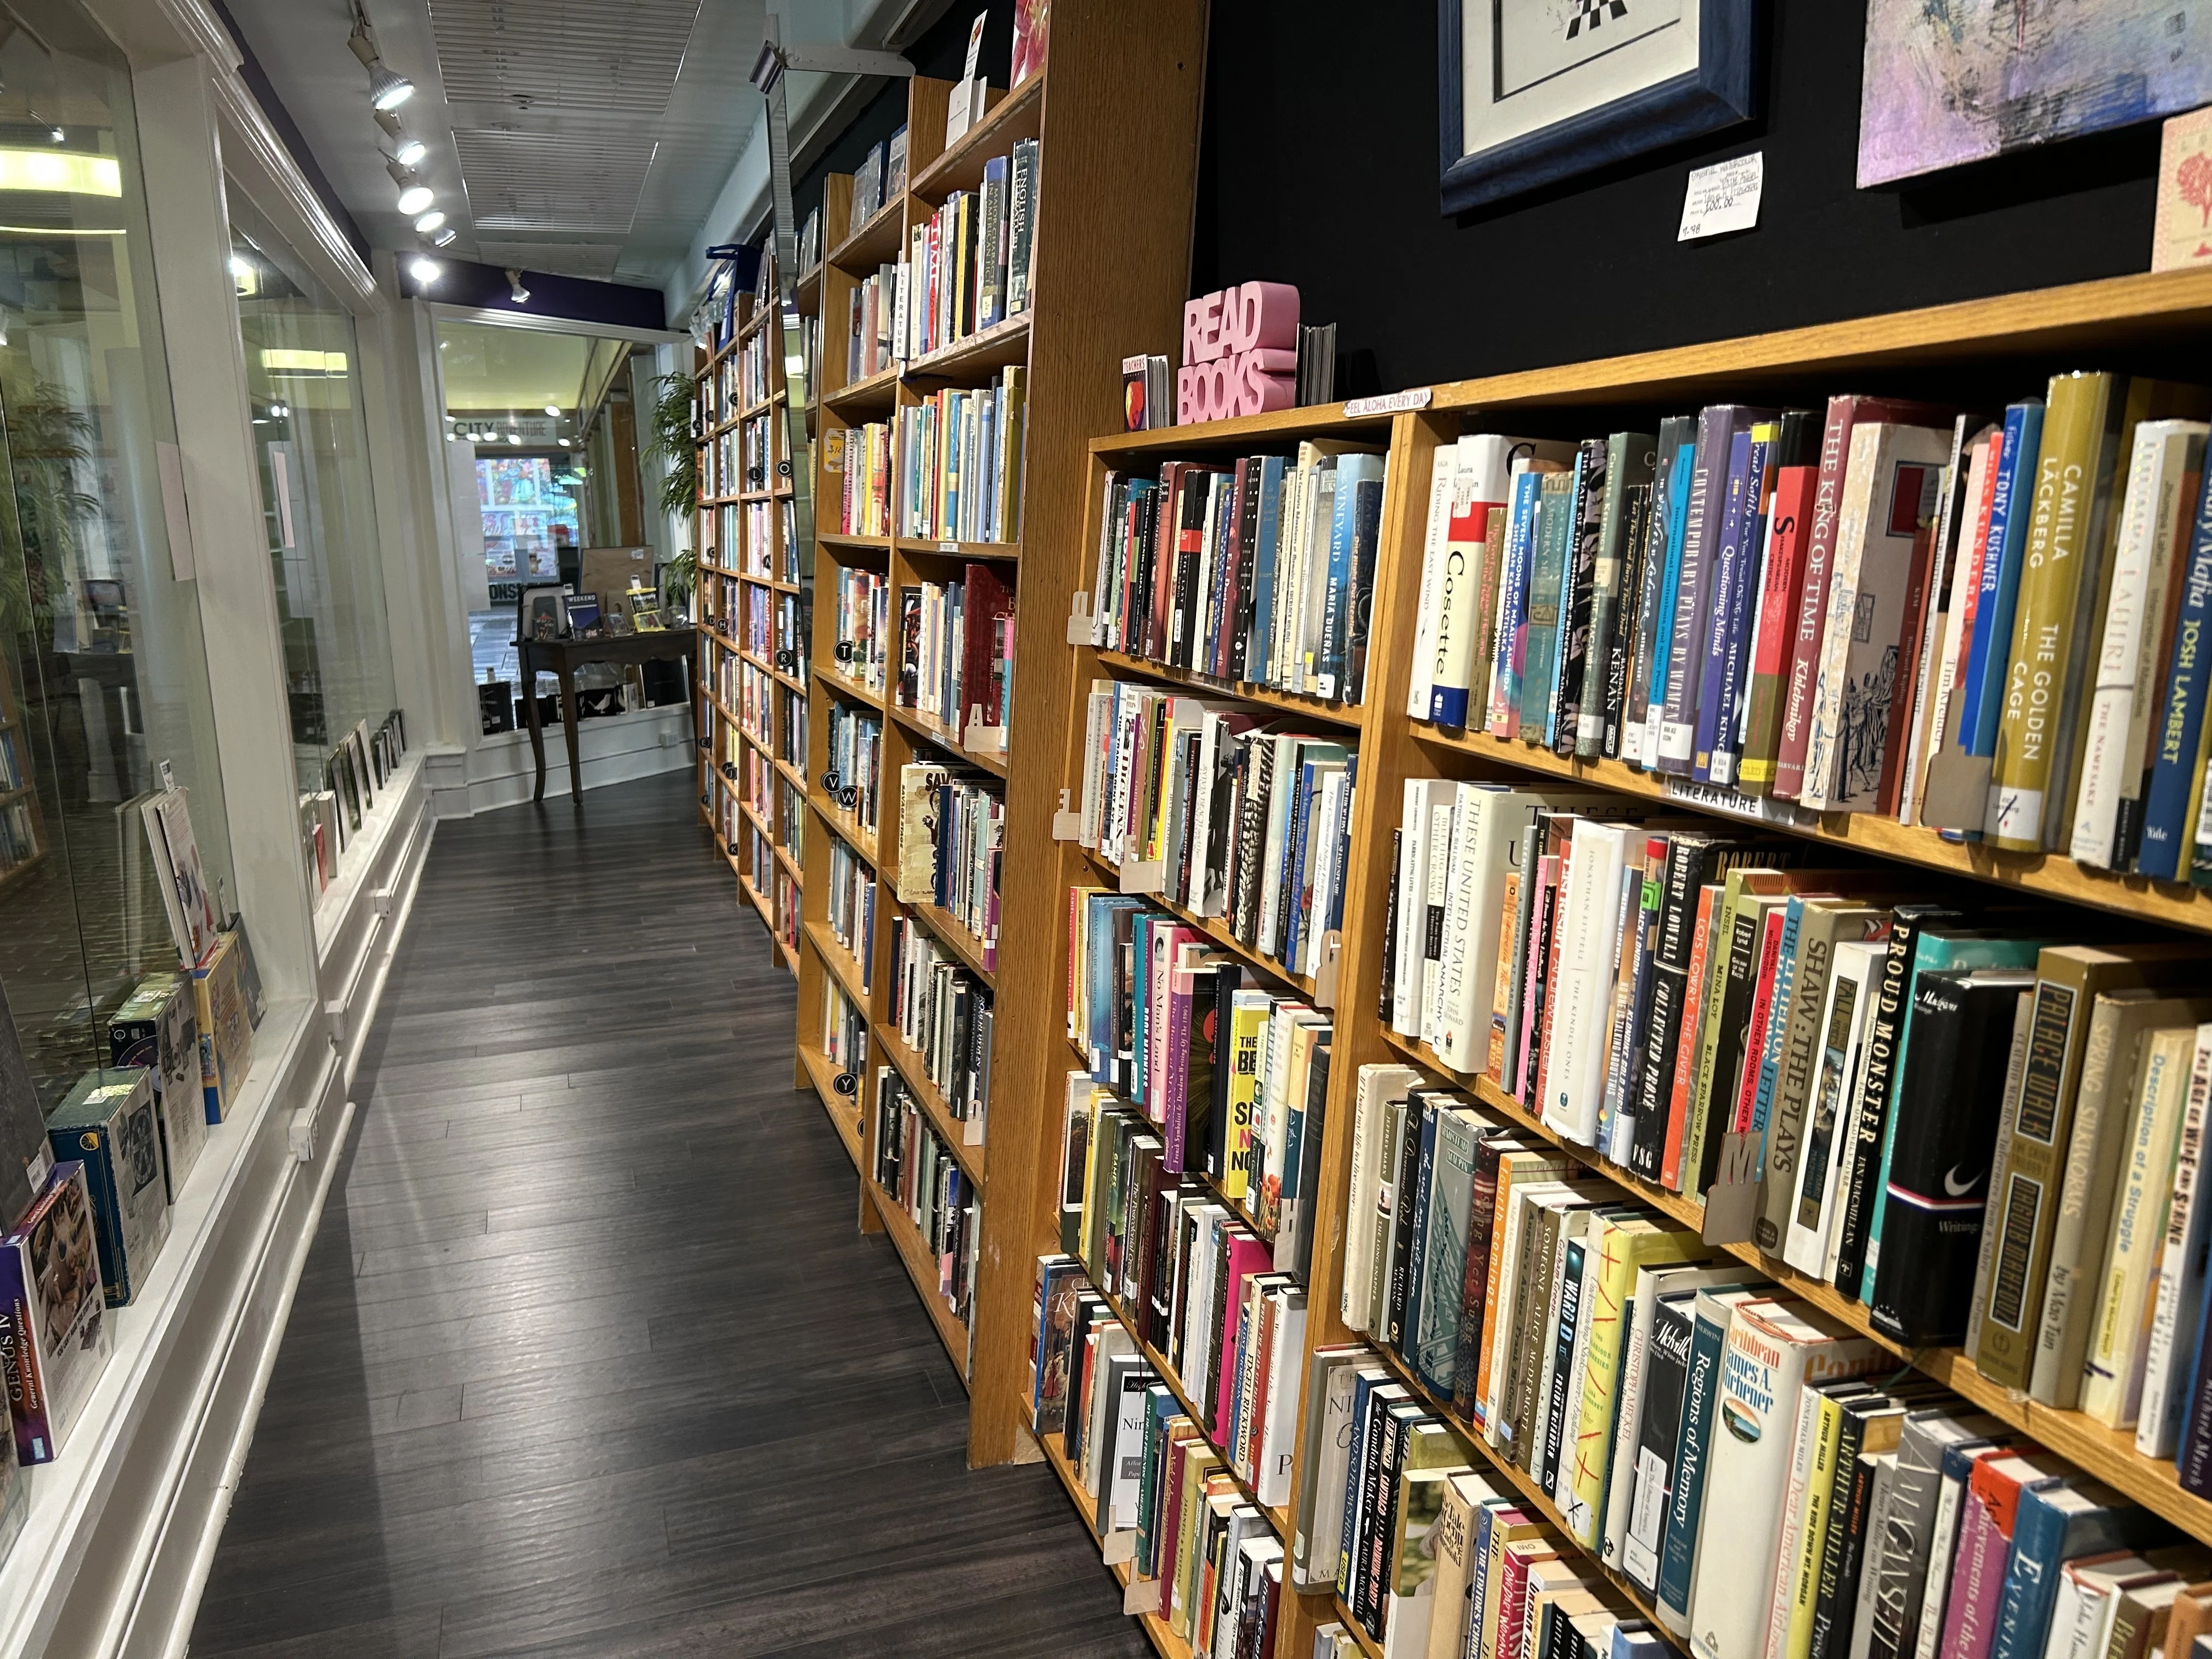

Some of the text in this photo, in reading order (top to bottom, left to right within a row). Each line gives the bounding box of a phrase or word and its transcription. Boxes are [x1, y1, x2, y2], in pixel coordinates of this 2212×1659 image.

[1018, 167, 1028, 233] ENGLISH
[1183, 281, 1262, 366] READ
[1123, 355, 1145, 374] TEACHERS
[1178, 349, 1264, 426] BOOKS
[454, 421, 494, 437] CITY
[1346, 391, 1429, 414] FEEL ALOHA EVERY DAY
[1457, 464, 1473, 474] Laura
[1579, 479, 1588, 508] TALE
[1606, 453, 1617, 495] CHARLES
[1745, 476, 1759, 517] Softly
[1330, 484, 1348, 562] VINEYARD
[1520, 507, 1529, 543] SEVEN
[1682, 469, 1709, 589] CONTEMPORARY
[1800, 419, 1844, 642] THE TIME
[1980, 469, 2011, 594] TONY KUSHNER
[2029, 457, 2058, 569] LÄCKBERG
[2051, 464, 2082, 561] CAMILLA
[1501, 523, 1519, 652] SHEHAN KARUNATILAKA
[1514, 545, 1524, 588] MOONS
[1964, 505, 1986, 611] KUNDERA
[1435, 550, 1464, 675] Cosette
[1509, 607, 1517, 637] MAALI
[1675, 591, 1692, 640] PLAYS
[1711, 545, 1735, 657] Questioning Minds
[2103, 567, 2136, 674] LAHIRI
[781, 653, 787, 663] R
[840, 645, 849, 657] T
[1502, 639, 1512, 692] ALMEIDA
[1585, 610, 1599, 672] MACABRE
[1606, 647, 1621, 712] KENAN
[1665, 665, 1685, 720] WOMEN
[1717, 642, 1737, 752] MICHAEL KING
[1790, 658, 1810, 743] Khlebnikov
[2007, 661, 2028, 720] CAGE
[2022, 624, 2058, 762] THE GOLDEN
[2160, 618, 2201, 765] JOSH LAMBERT
[828, 777, 839, 789] V
[840, 791, 856, 803] W
[1112, 737, 1120, 803] TRANSPARENT
[1117, 755, 1130, 838] DICKENS
[1671, 782, 1757, 812] LITERATURE
[2086, 735, 2106, 808] NAMESAKE
[1464, 799, 1481, 856] THESE
[2146, 825, 2168, 842] Yale
[1454, 860, 1474, 932] UNITED
[1576, 849, 1595, 962] JONATHAN LITTELL
[1662, 844, 1690, 961] ROBERT LOWELL
[1436, 892, 1453, 1024] INTELLECTUAL ANARCHY
[1448, 935, 1467, 998] STATES
[1783, 916, 1799, 954] THE
[1547, 958, 1559, 1013] Andrew
[1676, 917, 1707, 1086] LOIS LOWRY THE GIVER
[1154, 969, 1165, 1074] No Man's Land
[1239, 1036, 1257, 1049] THE
[1540, 1016, 1553, 1079] Lipstein
[1564, 1004, 1578, 1081] KINDLY ONES
[1642, 980, 1671, 1113] COLLECTED PROSE
[1690, 905, 1733, 1164] INSEL MINA LOY BLACK SPARROW PRESS
[1857, 923, 1909, 1144] PROUD MONSTER
[840, 1078, 851, 1090] Y
[1787, 1034, 1813, 1085] THE
[2019, 985, 2073, 1140] PALACE WALK
[1773, 1090, 1802, 1174] PLAYS
[2063, 1023, 2110, 1218] SPRING SILKWORMS
[2118, 1054, 2166, 1254] Description Struggle
[1446, 1148, 1469, 1173] MAUPIN
[1486, 1165, 1509, 1307] fourth comings
[2008, 1177, 2039, 1244] NAGUIB
[1393, 1266, 1405, 1311] RICHARD
[1465, 1193, 1491, 1345] Song Sung
[1562, 1277, 1579, 1326] WARD
[14, 1298, 25, 1336] Questions
[1519, 1223, 1552, 1433] SOMEONE ALICE McDERMOTT
[1649, 1318, 1691, 1362] Melville
[1696, 1321, 1721, 1343] MERWIN
[1, 1334, 24, 1402] GENUS
[1621, 1328, 1644, 1442] CHRISTOPH MECKEL
[1238, 1353, 1254, 1463] EDGELL RICKWORD
[1672, 1351, 1712, 1530] Regions Memory
[1816, 1410, 1831, 1472] ARTHUR MILLER
[1356, 1418, 1382, 1615] Gondola Maker LAURA MORELLI
[1490, 1529, 1500, 1562] THE
[1778, 1478, 1804, 1596] Dear American
[1819, 1425, 1857, 1600] ARTHUR MILLER
[1339, 1556, 1348, 1585] USED
[1478, 1547, 1487, 1568] THE
